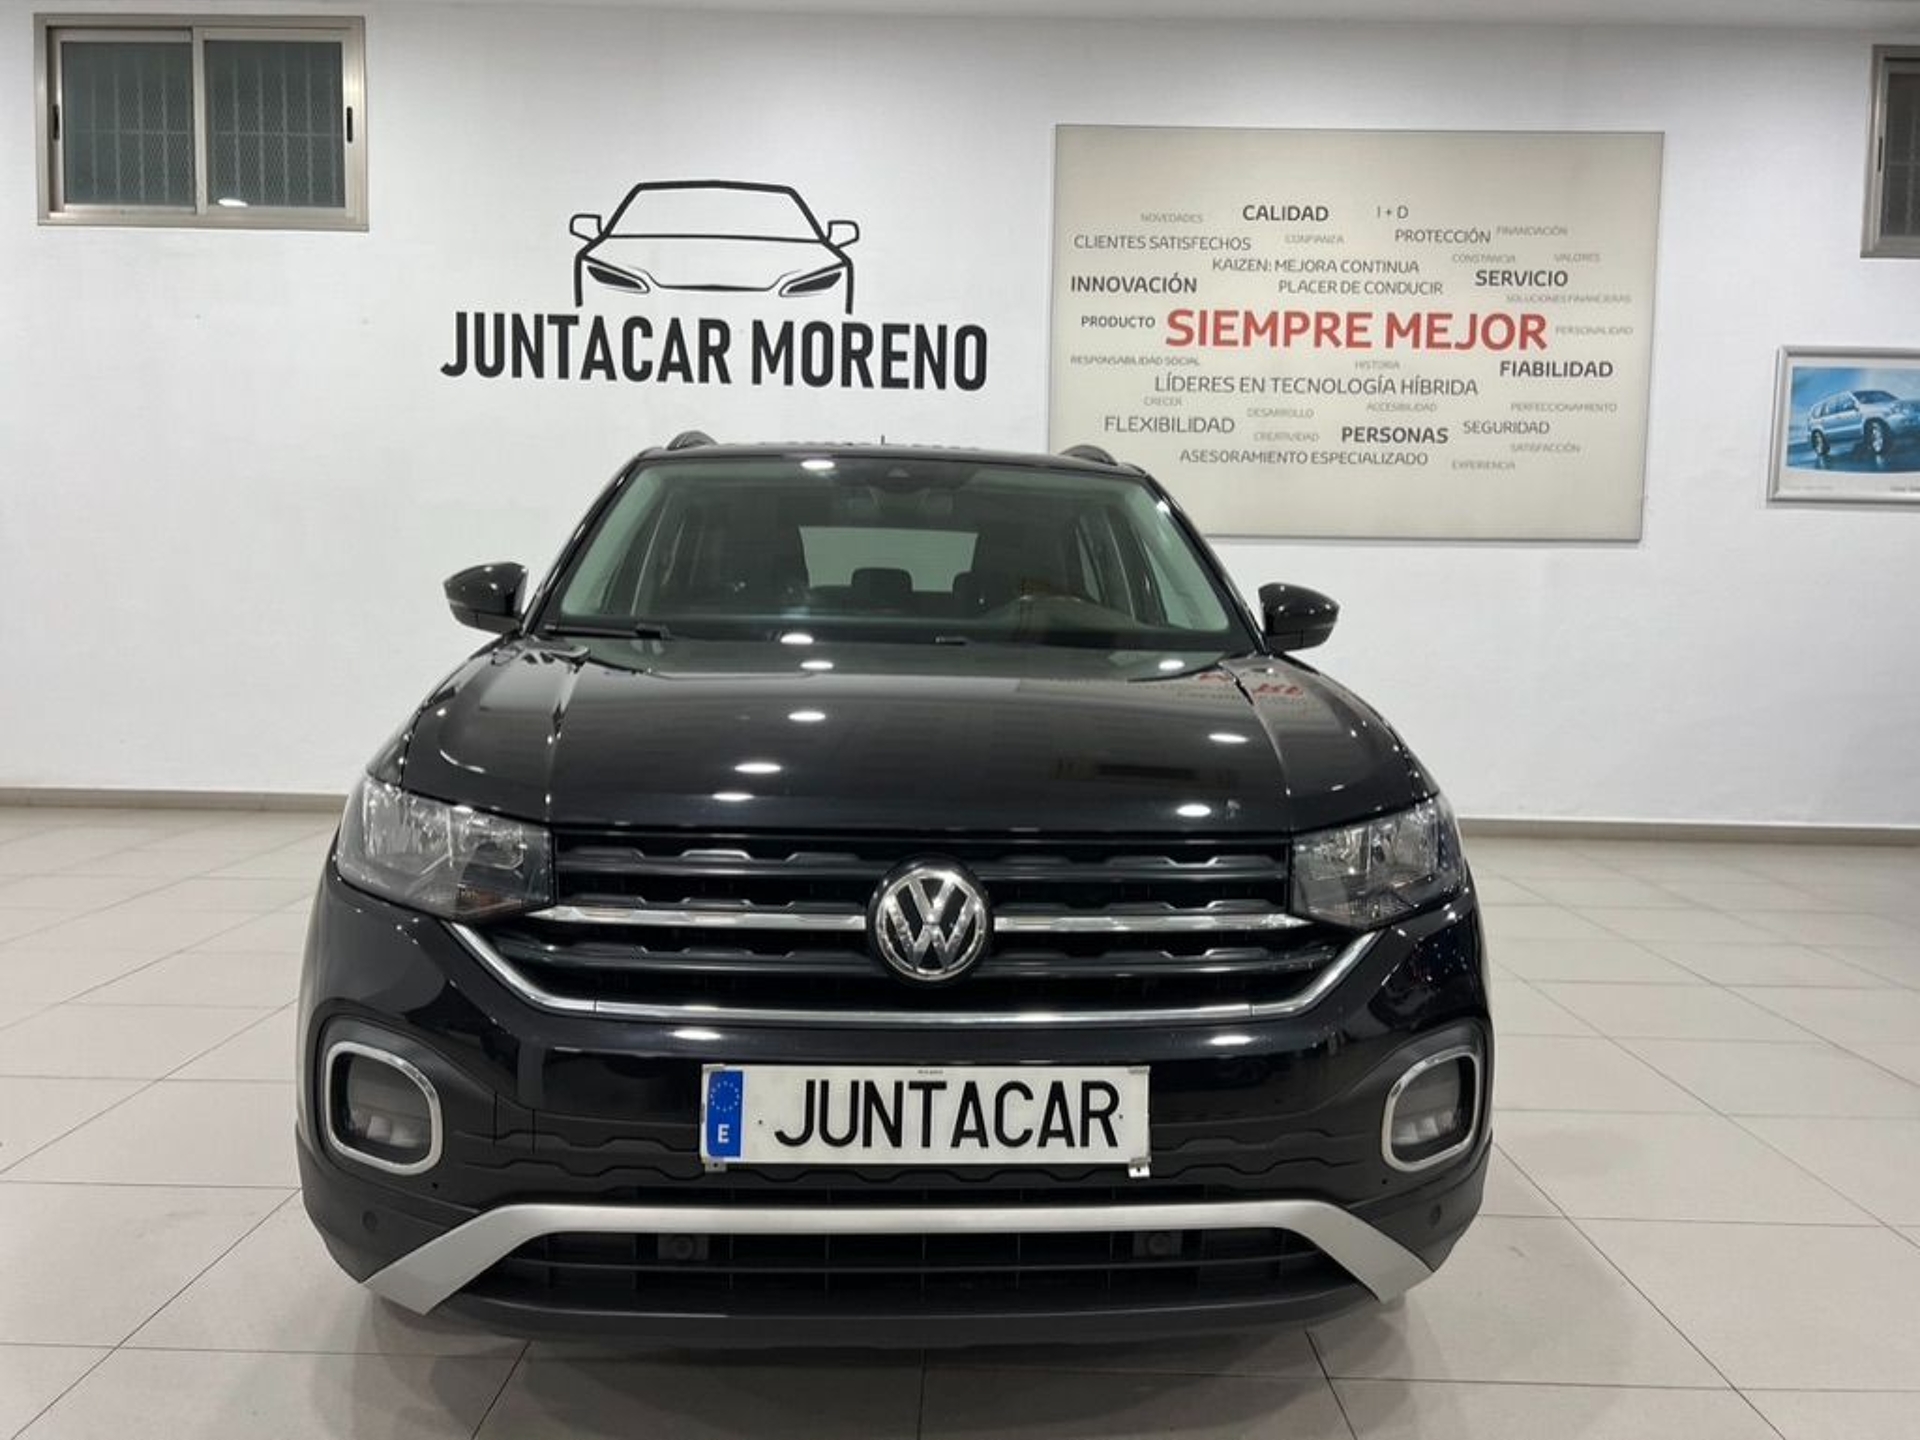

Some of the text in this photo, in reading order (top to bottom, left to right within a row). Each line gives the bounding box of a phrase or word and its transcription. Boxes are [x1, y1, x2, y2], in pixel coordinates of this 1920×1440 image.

[1140, 212, 1203, 223] NOVEDADES
[1242, 204, 1329, 221] CALIDAD
[1397, 206, 1409, 218] D
[1074, 235, 1252, 251] CLIENTES SATISFECHOS
[1285, 234, 1344, 244] CONFIANZA
[1395, 228, 1491, 244] PROTECCIÓN
[1452, 253, 1516, 264] CONSTANCIA
[1554, 253, 1600, 263] VALORES
[1212, 258, 1419, 274] KAIZEN: MEJORA CONTINUA
[1070, 272, 1197, 294] INNOVACIÓN
[1475, 270, 1568, 287] SERVICIO
[1278, 279, 1443, 295] PLACER DE CONDUCIR
[1081, 315, 1156, 328] PRODUCTO
[1165, 308, 1548, 351] SIEMPRE MEJOR
[1555, 326, 1633, 336] PERSONALIDAD
[440, 310, 988, 391] JUNTACAR MORENO
[1070, 355, 1200, 366] RESPONSABILIDAD SOCIAL
[1355, 360, 1400, 370] HISTORIA
[1500, 360, 1613, 377] FIABILIDAD
[1155, 372, 1478, 396] LÍDERES EN TECNOLOGÍA HÍBRIDA
[1144, 396, 1182, 406] CRECER
[1247, 407, 1314, 418] DESARROLLO
[1105, 416, 1235, 433] FLEXIBILIDAD
[1463, 421, 1550, 435] SEGURIDAD
[1254, 432, 1319, 442] CREATIVIDAD
[1342, 426, 1449, 444] PERSONAS
[1180, 450, 1428, 465] ASESORAMIENTO ESPECIALIZADO
[1452, 460, 1515, 470] EXPERIENCIA
[775, 1079, 1118, 1148] JUNTACAR
[717, 1124, 730, 1143] E
